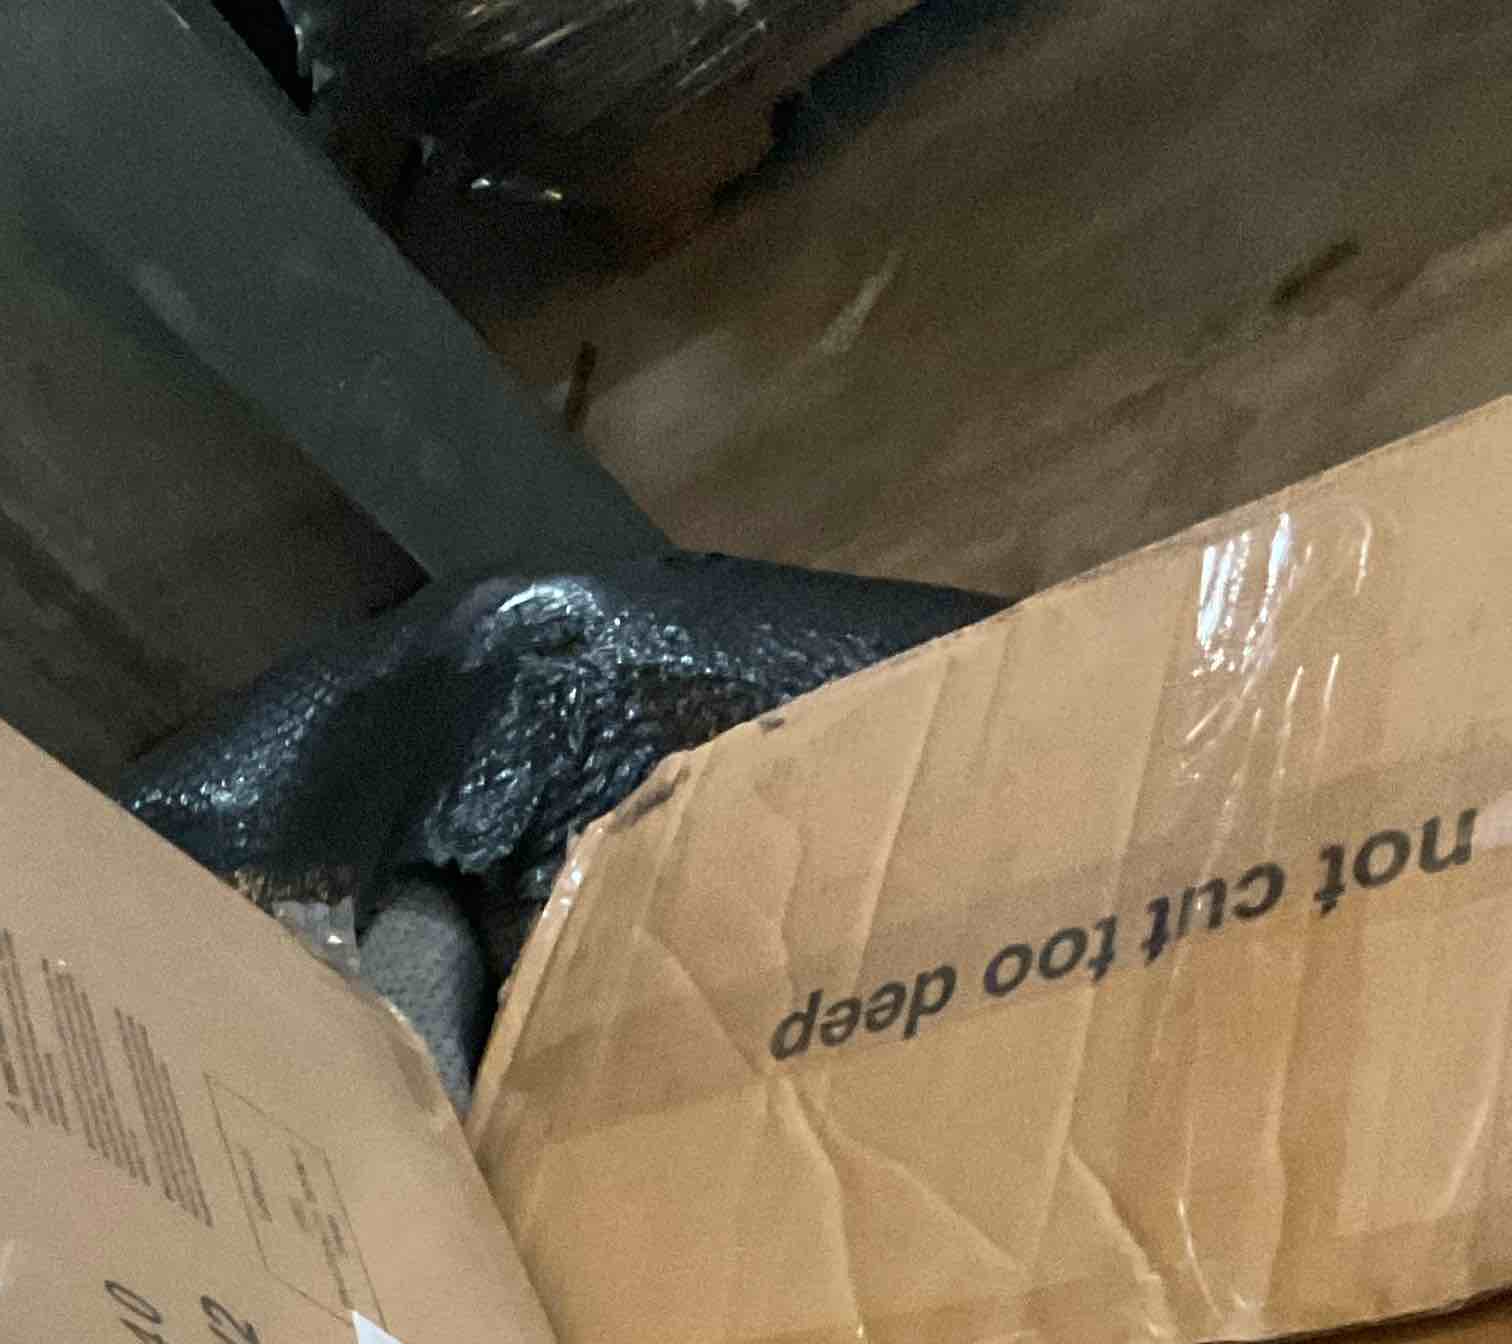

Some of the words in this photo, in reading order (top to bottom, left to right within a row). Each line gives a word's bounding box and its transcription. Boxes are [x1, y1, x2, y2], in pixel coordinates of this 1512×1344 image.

[1314, 807, 1478, 917] not
[983, 914, 1118, 983] too
[1140, 861, 1286, 964] cut
[769, 963, 958, 1061] deep
